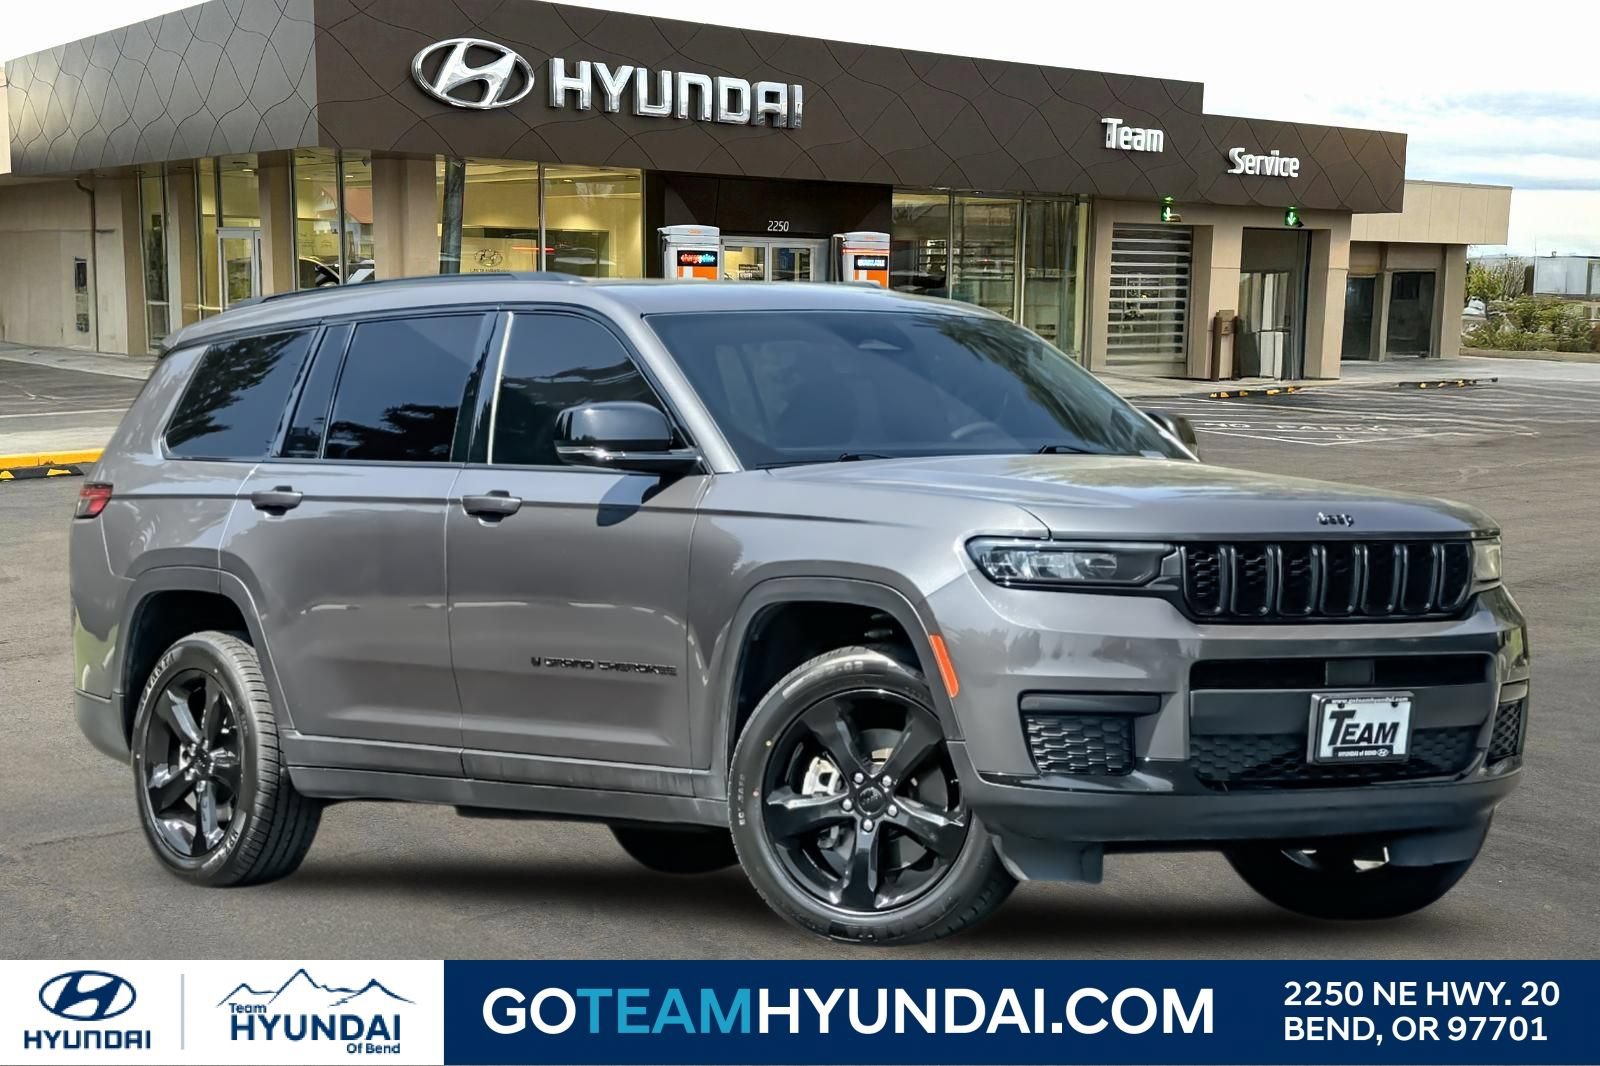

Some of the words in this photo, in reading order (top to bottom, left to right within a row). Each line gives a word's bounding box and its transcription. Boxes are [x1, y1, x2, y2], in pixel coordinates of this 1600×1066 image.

[548, 57, 803, 129] HYUNDAI
[1101, 117, 1164, 153] Team
[1227, 147, 1300, 178] Service
[767, 220, 790, 232] 2250
